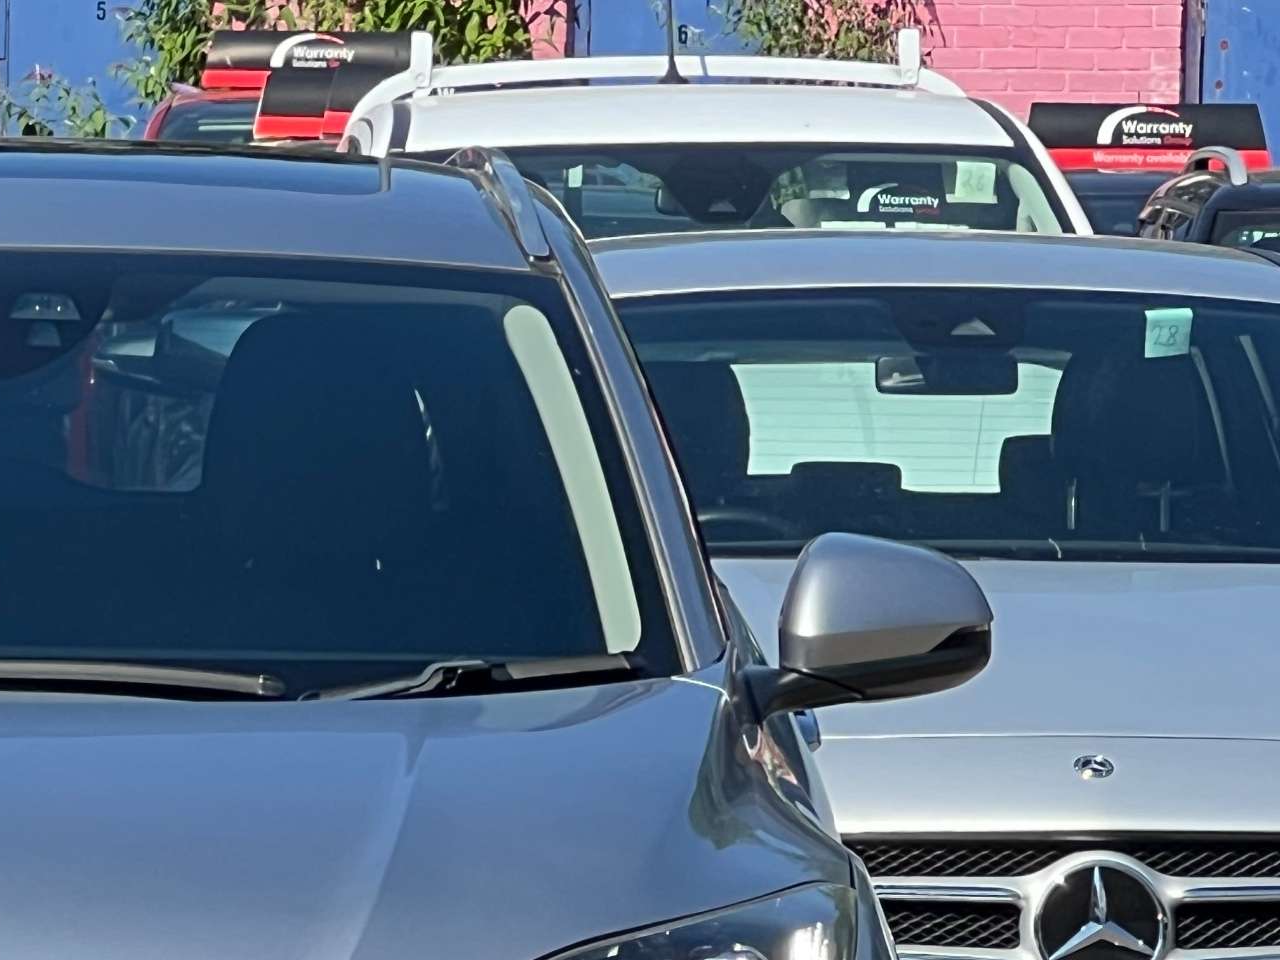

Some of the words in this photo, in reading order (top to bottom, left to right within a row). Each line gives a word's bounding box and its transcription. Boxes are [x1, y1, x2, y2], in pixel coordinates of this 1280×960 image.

[96, 0, 106, 21] 5
[678, 24, 688, 45] 6
[293, 47, 355, 63] Warranty
[1122, 120, 1193, 138] Warranty
[878, 194, 939, 208] Warranty
[1152, 325, 1178, 346] 28
